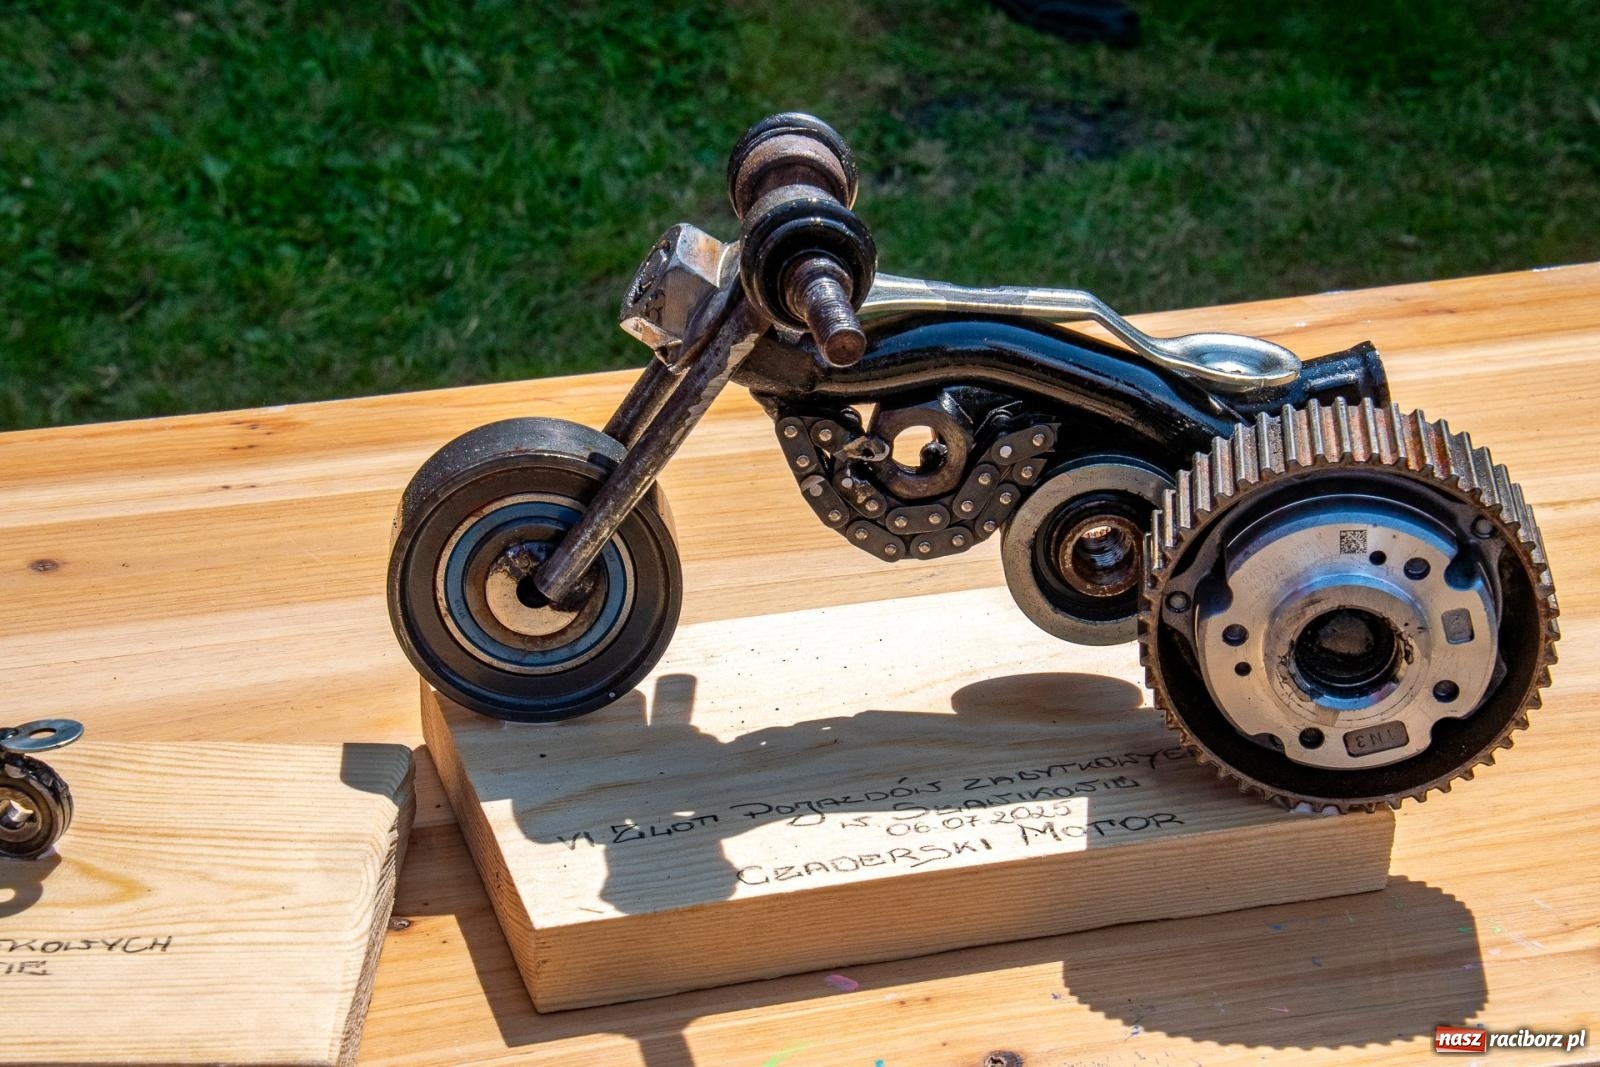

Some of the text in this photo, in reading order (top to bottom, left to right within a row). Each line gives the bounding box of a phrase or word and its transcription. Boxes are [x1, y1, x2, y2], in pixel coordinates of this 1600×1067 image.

[556, 830, 597, 851] VI
[736, 811, 1185, 886] CZADERSKI MOTOR
